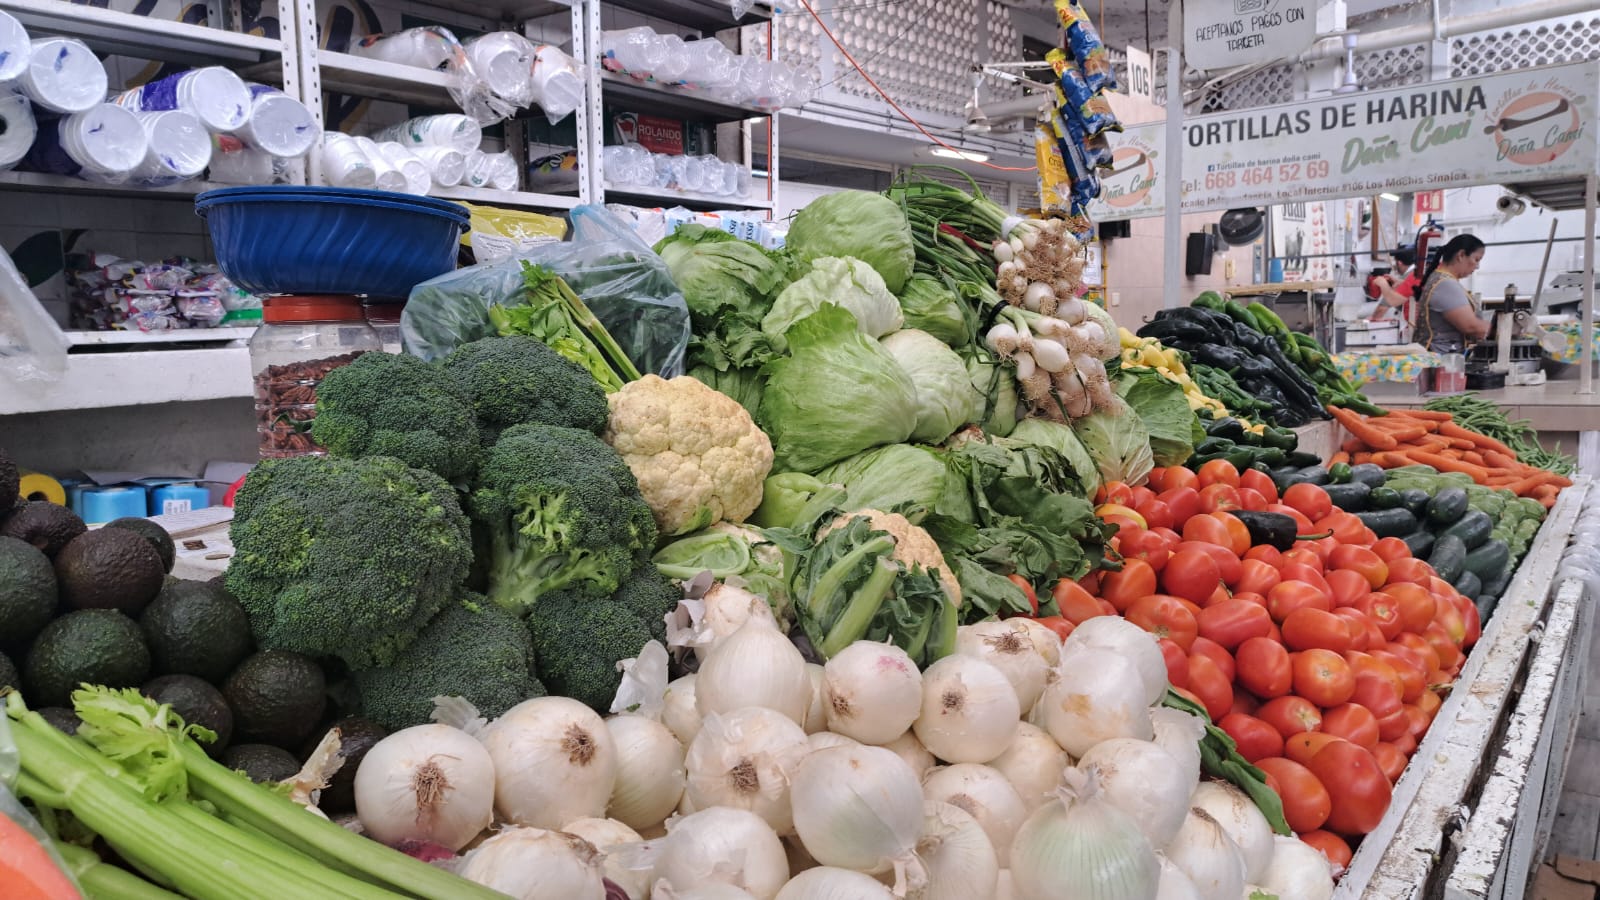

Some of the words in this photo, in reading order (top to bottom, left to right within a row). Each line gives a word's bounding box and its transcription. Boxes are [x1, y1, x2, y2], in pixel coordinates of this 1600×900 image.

[1252, 13, 1281, 32] PAGOS
[1286, 8, 1305, 22] CON
[1131, 63, 1149, 96] 106
[1182, 110, 1311, 147] ORTILLAS
[1321, 103, 1356, 131] DE
[1367, 85, 1487, 125] HARINA
[638, 124, 682, 140] ROLANDO
[1340, 135, 1400, 174] Doña
[1410, 110, 1475, 152] Cami
[1496, 137, 1535, 162] Doña
[1544, 121, 1586, 148] Cami
[1205, 171, 1236, 190] 668
[1241, 166, 1273, 186] 464
[1279, 163, 1301, 182] 52
[1307, 160, 1329, 179] 69
[1216, 159, 1246, 171] Tortillas
[1247, 160, 1256, 168] de
[1302, 152, 1321, 161] cami
[1130, 172, 1159, 194] Cami
[1304, 184, 1339, 196] Interior
[1366, 179, 1383, 190] Los
[1385, 176, 1424, 187] Mochis
